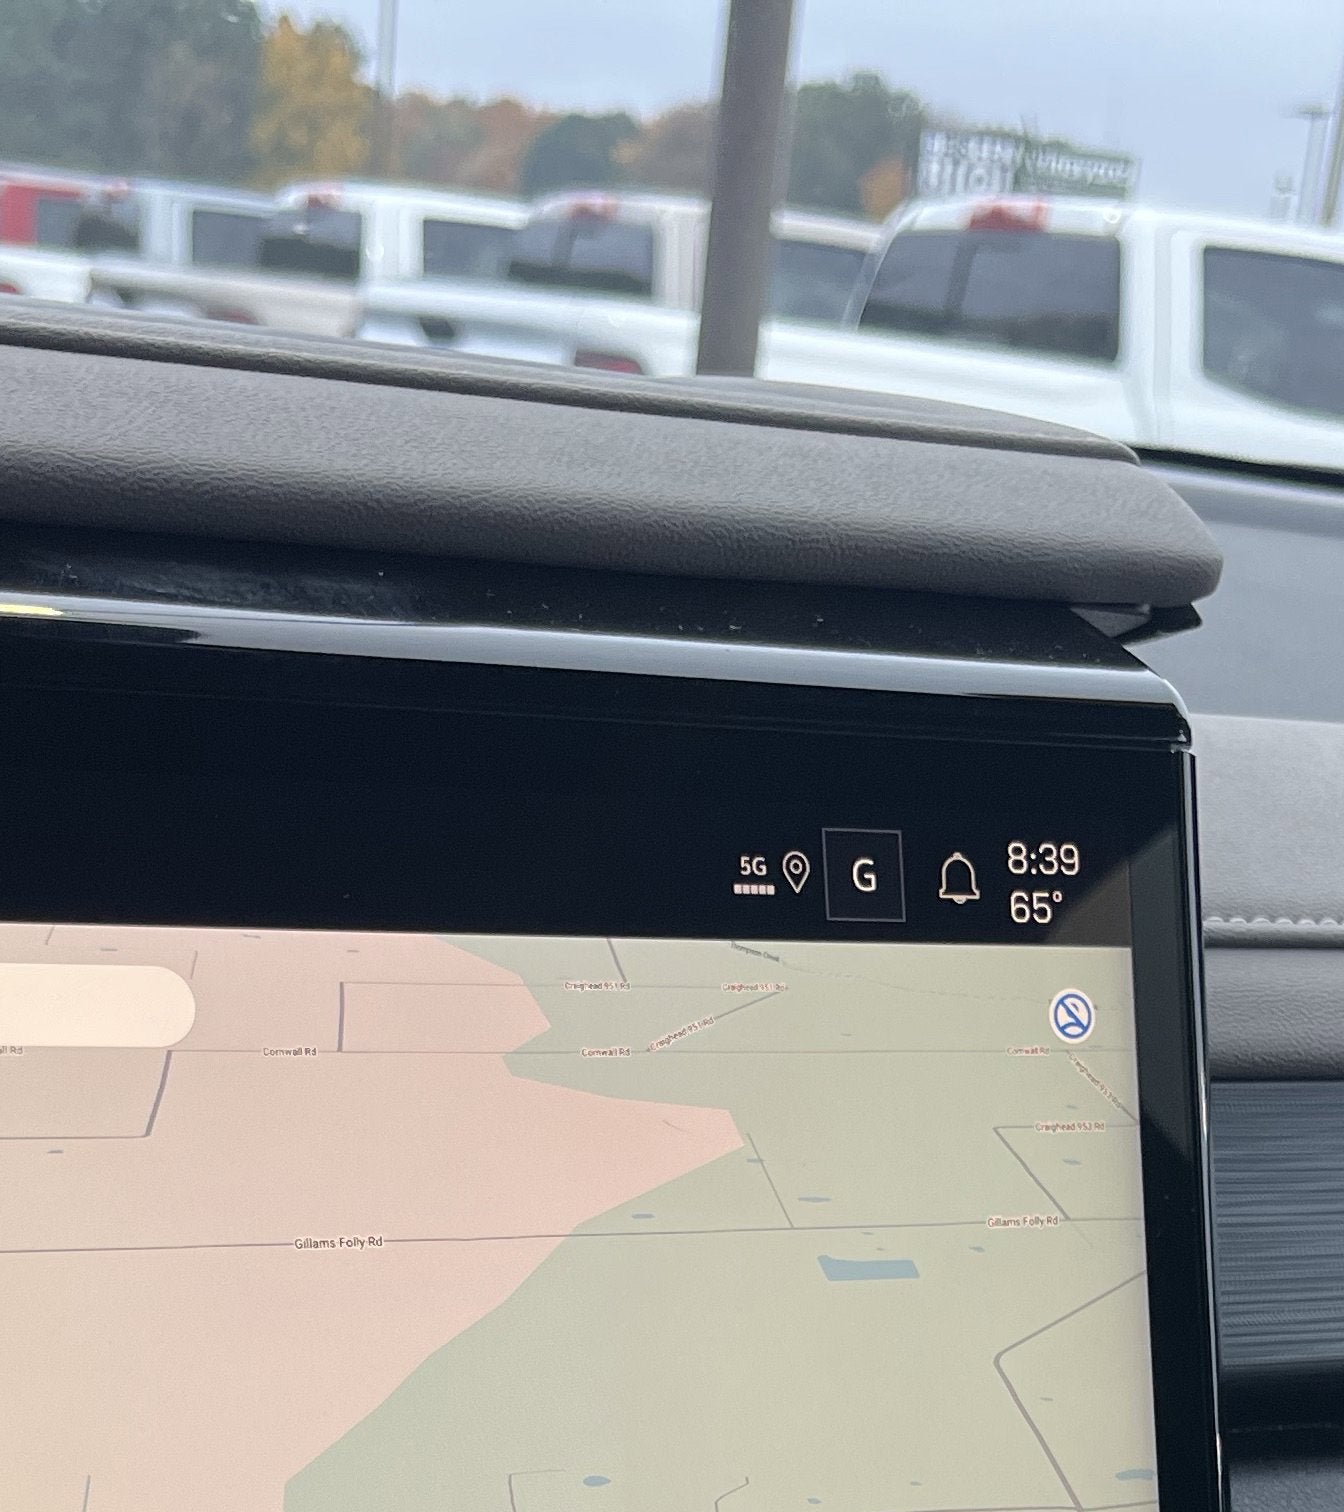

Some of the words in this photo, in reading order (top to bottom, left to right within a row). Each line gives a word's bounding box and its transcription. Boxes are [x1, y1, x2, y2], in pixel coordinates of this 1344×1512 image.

[1008, 842, 1079, 876] 8:39
[740, 856, 767, 876] 5G
[852, 858, 877, 892] G
[1010, 890, 1063, 924] 65°
[10, 1046, 23, 1055] Rd
[263, 1047, 303, 1056] Cornwall
[305, 1047, 317, 1056] Rd
[582, 1048, 618, 1057] Cornwall
[619, 1048, 631, 1057] Rd
[1095, 1122, 1105, 1131] Rd
[1023, 1216, 1044, 1228] Folly
[1046, 1215, 1058, 1225] Rd
[294, 1237, 336, 1249] Gillams
[339, 1236, 365, 1250] Folly
[368, 1236, 383, 1247] Rd
